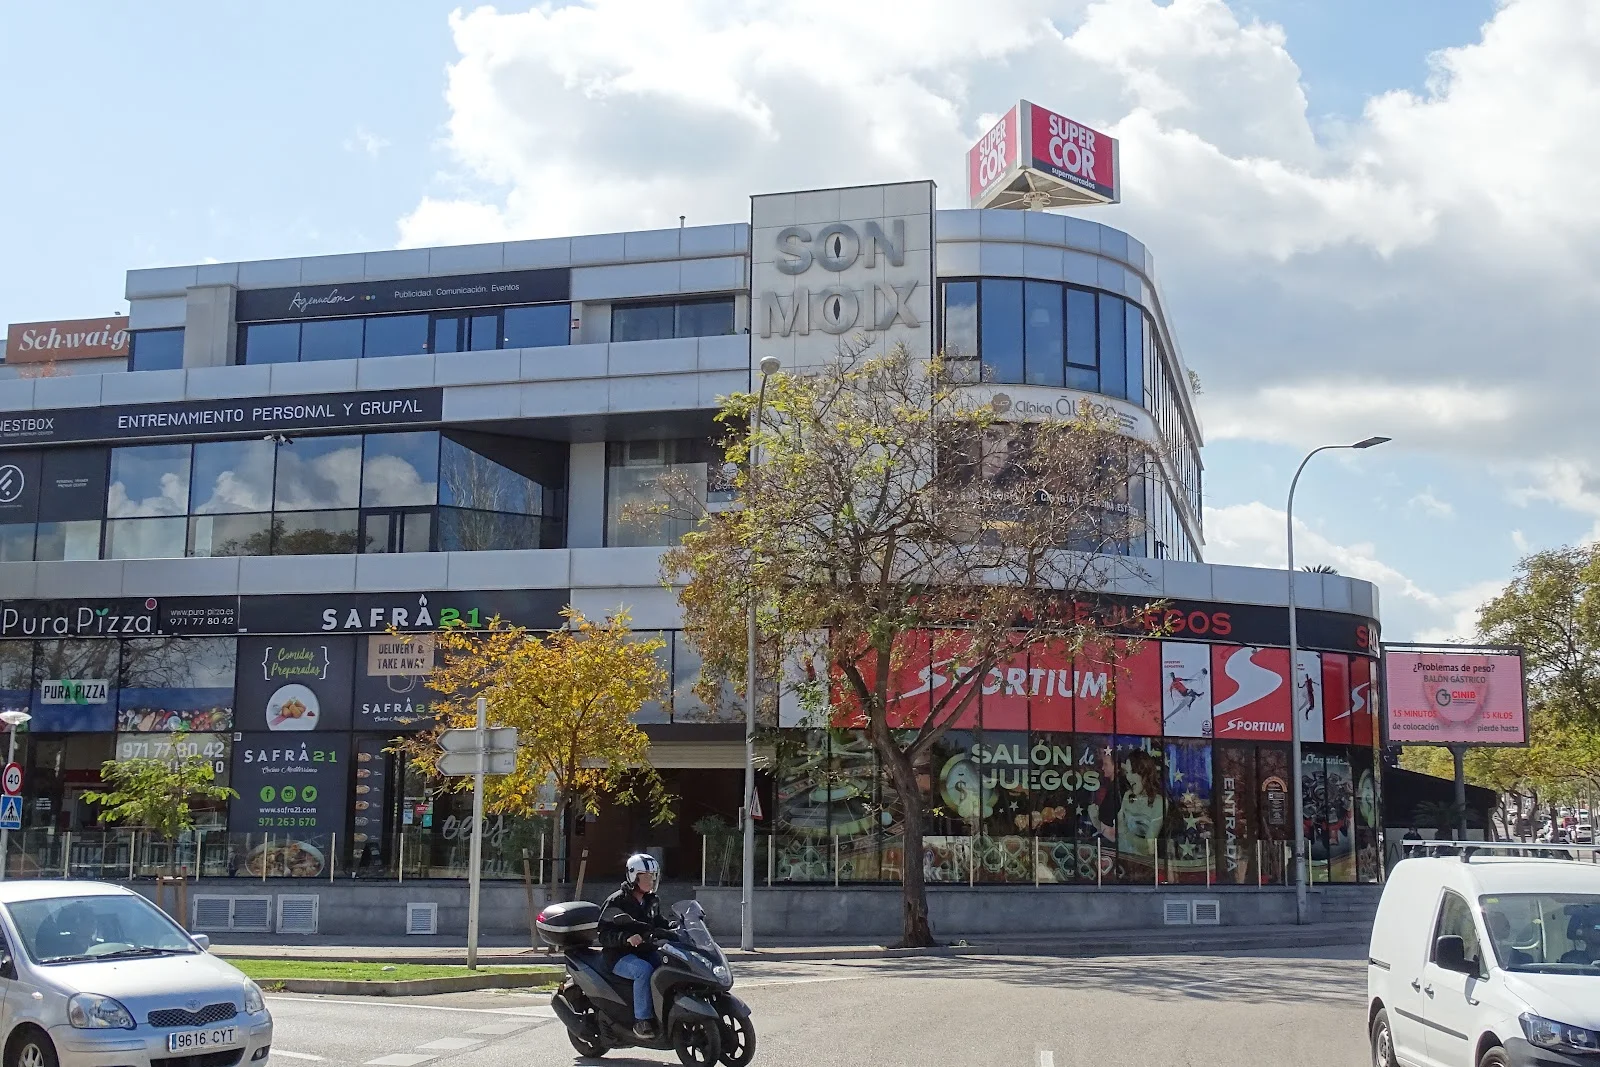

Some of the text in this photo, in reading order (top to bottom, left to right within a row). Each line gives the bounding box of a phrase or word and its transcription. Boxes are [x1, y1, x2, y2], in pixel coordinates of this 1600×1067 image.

[979, 119, 1007, 161] SUPER
[1048, 114, 1096, 152] SUPER
[979, 141, 1007, 187] COR
[1049, 136, 1096, 181] COR
[1051, 167, 1096, 190] supermercados
[774, 220, 905, 276] SON
[491, 283, 520, 292] Eventos
[760, 279, 921, 338] MOIX
[118, 400, 423, 429] ENTRENAMIENTO PERSONAL Y GRUPAL
[2, 607, 151, 635] Pura Pizza
[170, 616, 234, 626] 971 77 80 42
[1103, 602, 1233, 635] JUEGOS
[278, 647, 315, 661] Comidas
[378, 643, 424, 655] DELIVERY &
[271, 662, 321, 679] Preparadas
[378, 658, 425, 669] TAKE AWAY
[1413, 662, 1496, 674] ¿Problemas de peso?
[887, 659, 1108, 701] SPORTIUM
[1423, 674, 1486, 684] BALÓN GÁSTRICO
[44, 684, 106, 700] PURA PIZZA
[1452, 691, 1476, 699] CINIB
[1393, 710, 1437, 718] 15 MINUTOS
[1492, 711, 1513, 719] KILOS
[1219, 717, 1285, 733] SPORTIUM
[1392, 722, 1440, 731] de colocación
[1477, 724, 1519, 733] pierde hasta
[122, 742, 149, 758] 971
[153, 742, 171, 758] 77
[203, 742, 225, 758] 42
[971, 739, 1095, 766] SALÓN de
[8, 774, 20, 785] 40
[982, 768, 1100, 792] JUEGOS
[259, 806, 317, 814] www.safra21.com
[258, 817, 317, 827] 971 263 670
[1222, 777, 1238, 872] ENTRADA
[178, 1028, 235, 1047] 9616 CYT
